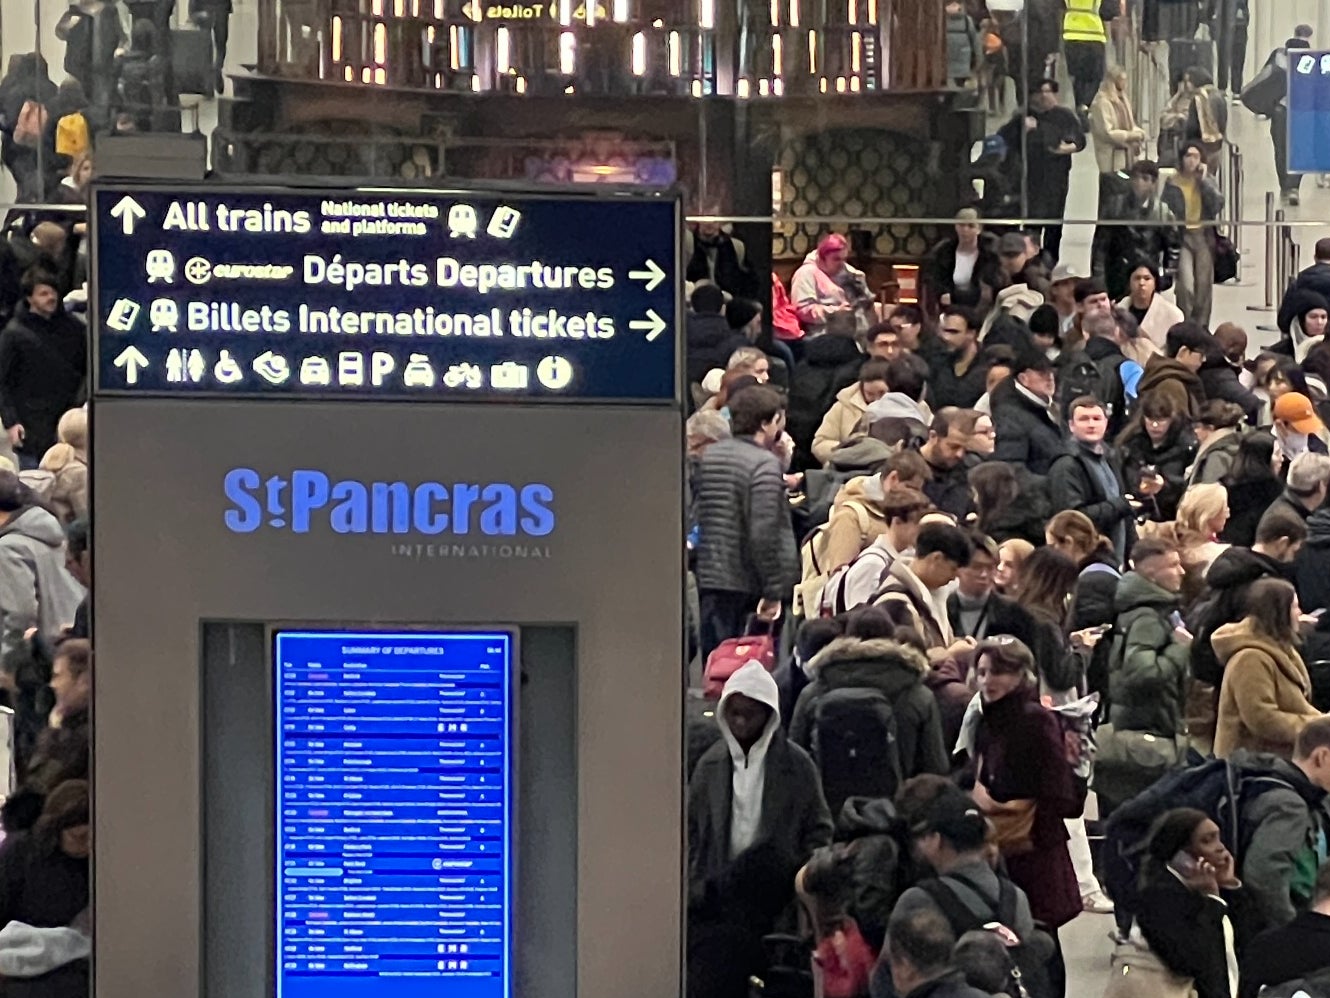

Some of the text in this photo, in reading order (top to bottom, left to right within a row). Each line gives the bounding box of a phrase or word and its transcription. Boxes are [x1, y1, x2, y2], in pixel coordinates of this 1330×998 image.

[163, 202, 310, 234] All trains
[321, 200, 439, 219] National tickets
[321, 219, 427, 237] and platforms
[213, 263, 293, 279] eurostar
[303, 253, 615, 294] Départs Departures
[187, 301, 615, 338] Billets International tickets
[392, 544, 552, 558] INTERNATIONAL
